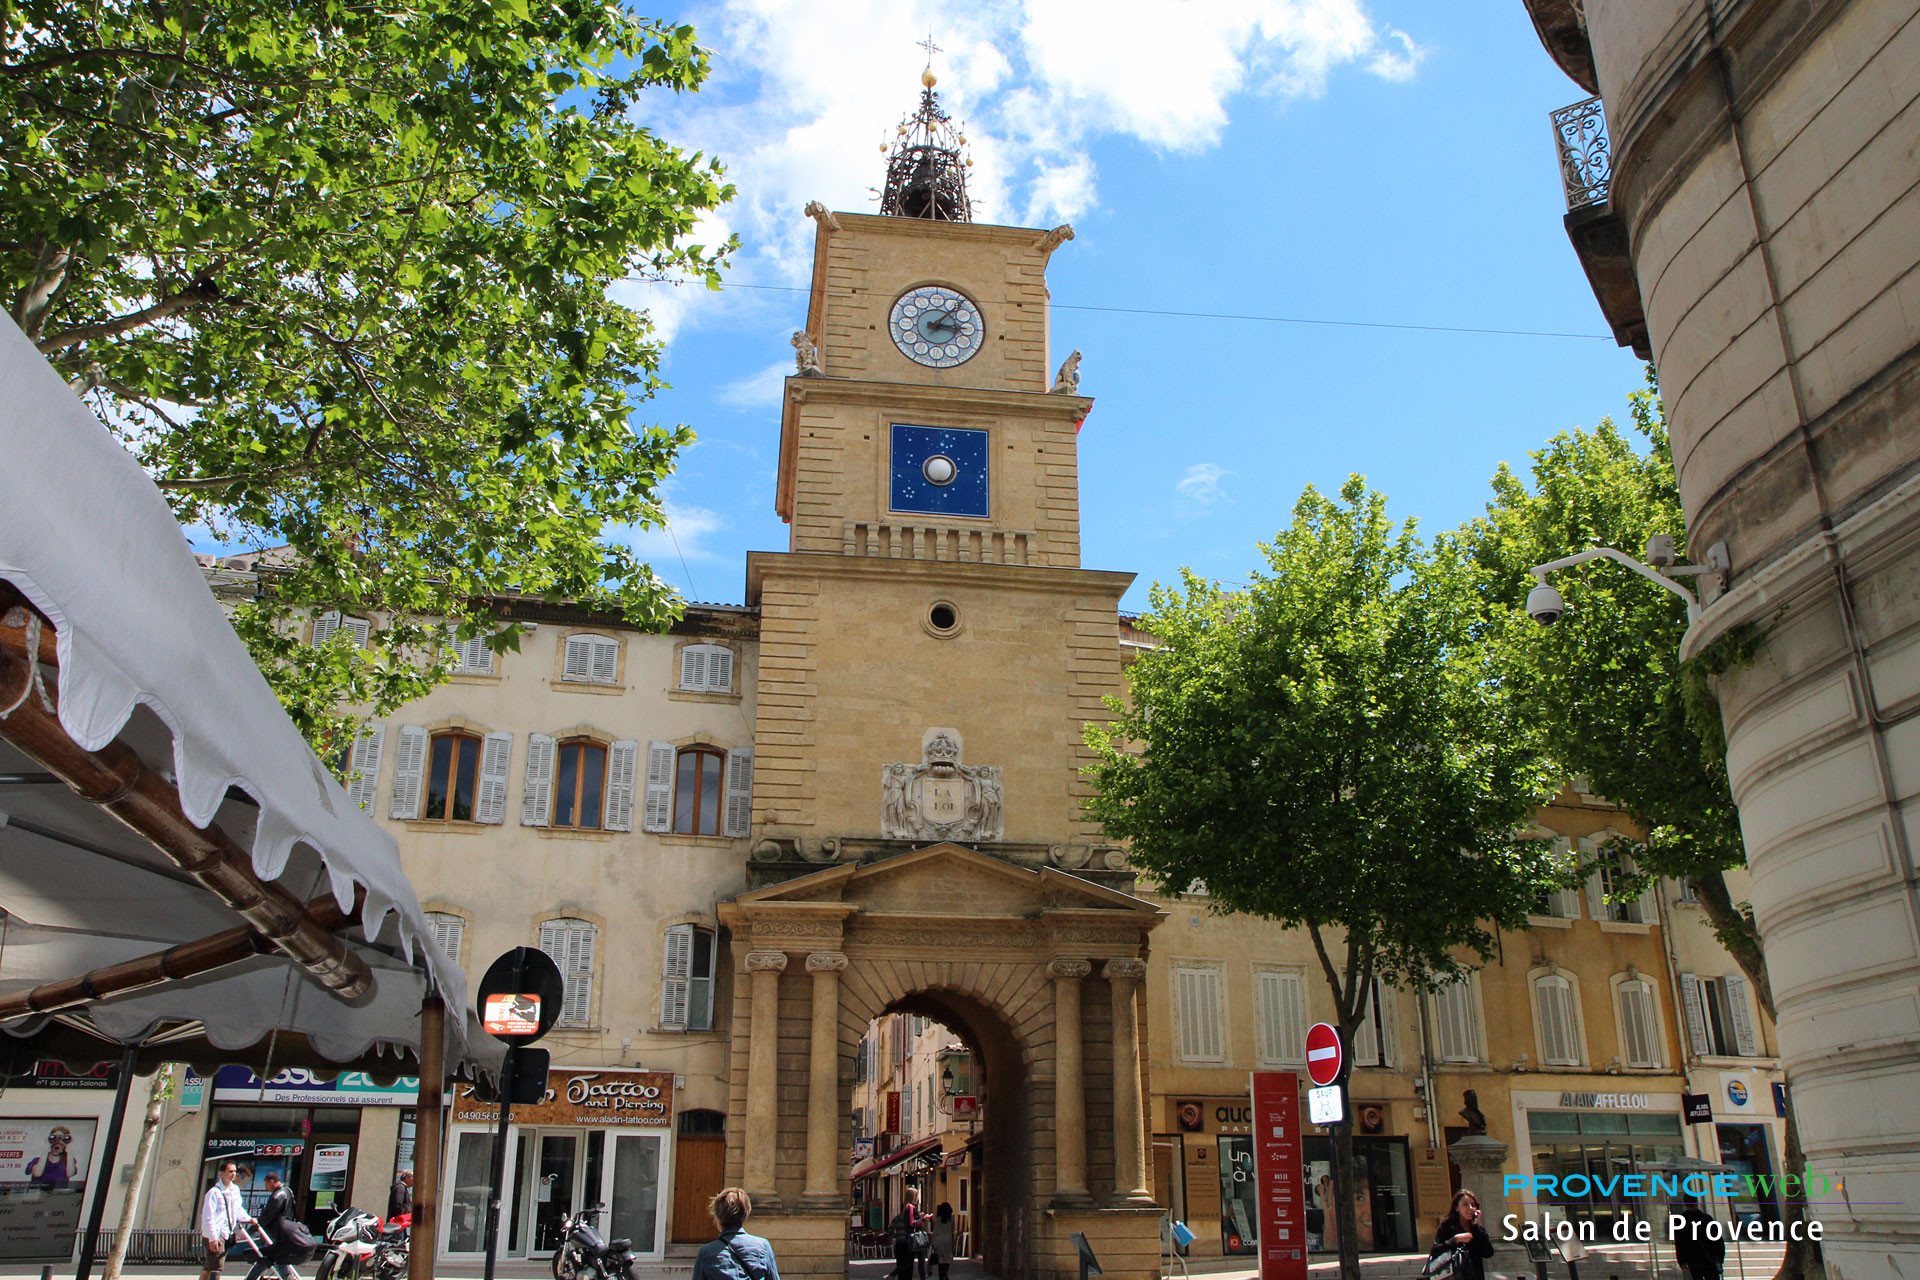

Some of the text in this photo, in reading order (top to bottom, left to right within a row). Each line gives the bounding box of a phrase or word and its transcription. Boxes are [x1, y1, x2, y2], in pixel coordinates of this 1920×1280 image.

[934, 788, 951, 797] LA
[934, 802, 954, 811] LOI
[184, 1078, 205, 1086] ASSU
[566, 1073, 660, 1104] Tattoo
[1315, 1088, 1333, 1099] SAUF
[275, 1093, 393, 1104] Des Professionnels qui assurent
[585, 1097, 665, 1114] and Piercing
[575, 1115, 668, 1125] www.aladin-tattoo.com
[208, 1139, 256, 1147] 08 2004 2000
